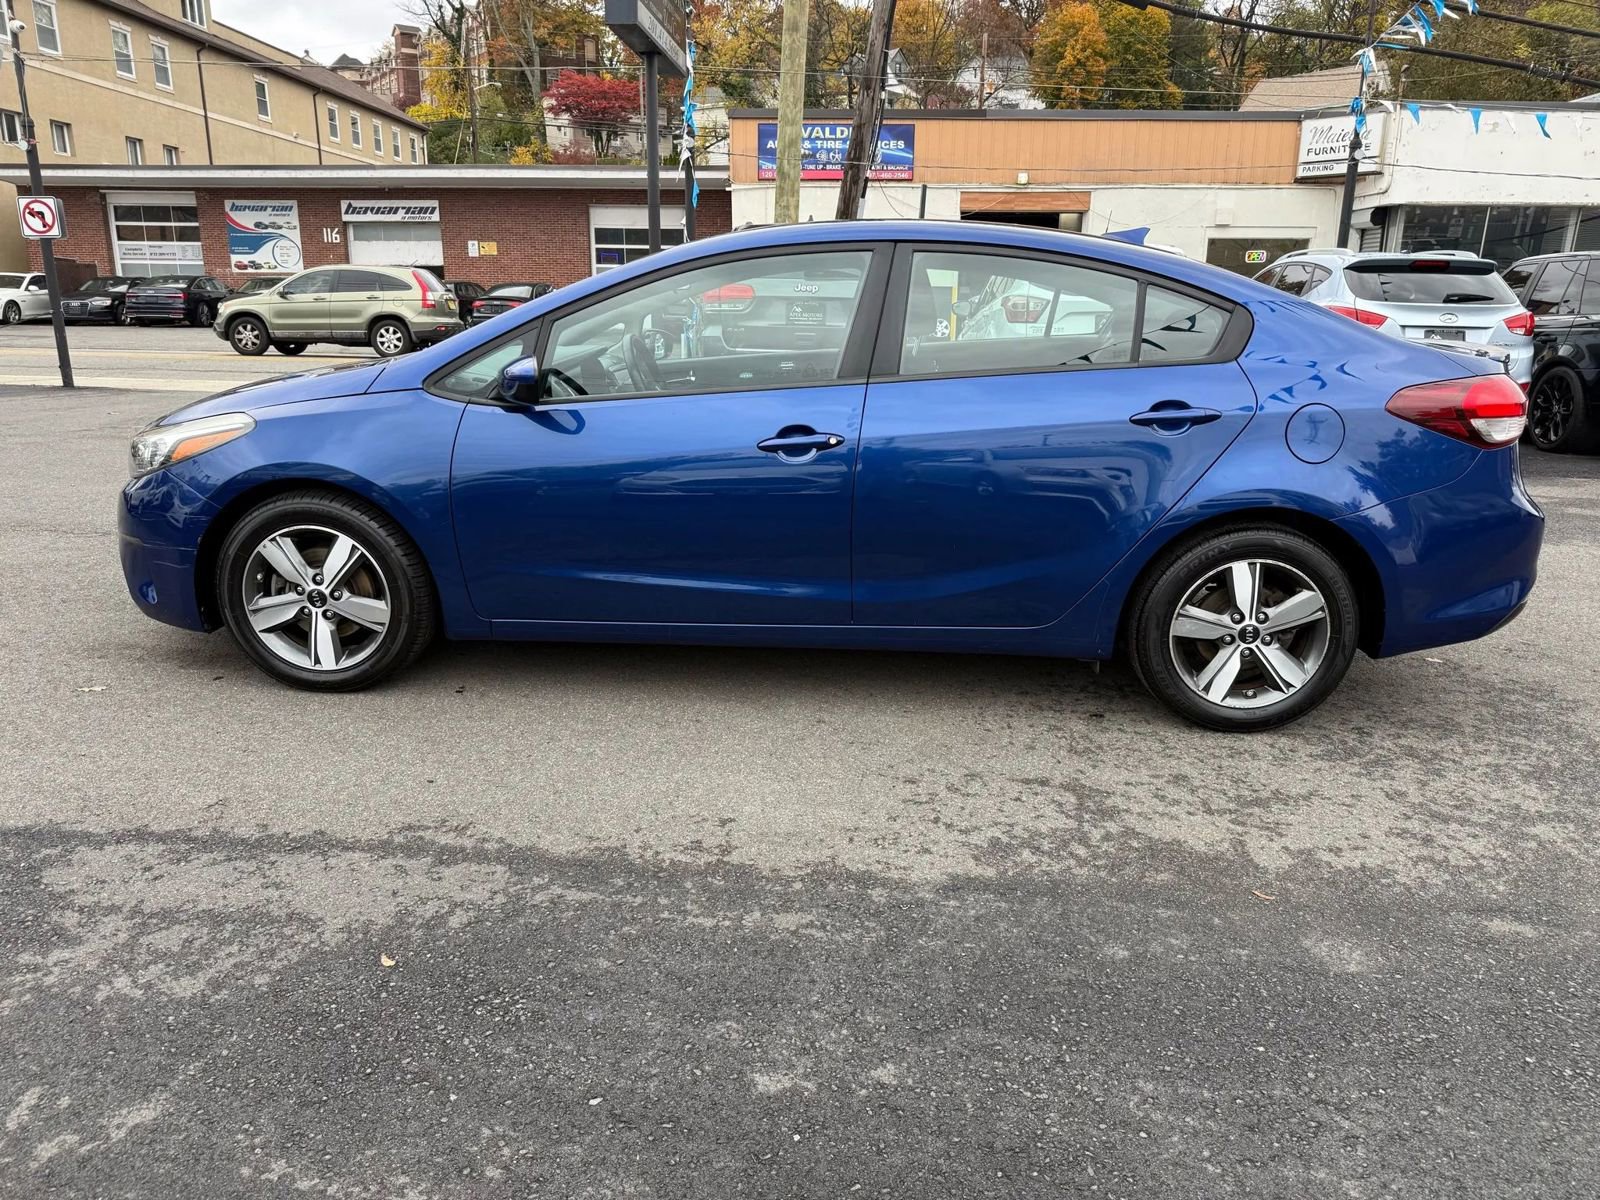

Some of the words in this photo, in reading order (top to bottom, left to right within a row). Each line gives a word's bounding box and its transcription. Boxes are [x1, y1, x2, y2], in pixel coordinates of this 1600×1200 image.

[815, 140, 843, 149] TIRE
[1306, 142, 1372, 157] FURNITE
[1302, 165, 1334, 173] PARKING
[229, 201, 294, 212] bavarian
[344, 201, 438, 215] bavarian
[323, 227, 341, 243] 116
[1247, 252, 1265, 261] OPEN
[794, 283, 819, 294] Jeep
[312, 590, 322, 607] KIA
[1245, 626, 1253, 643] KIA
